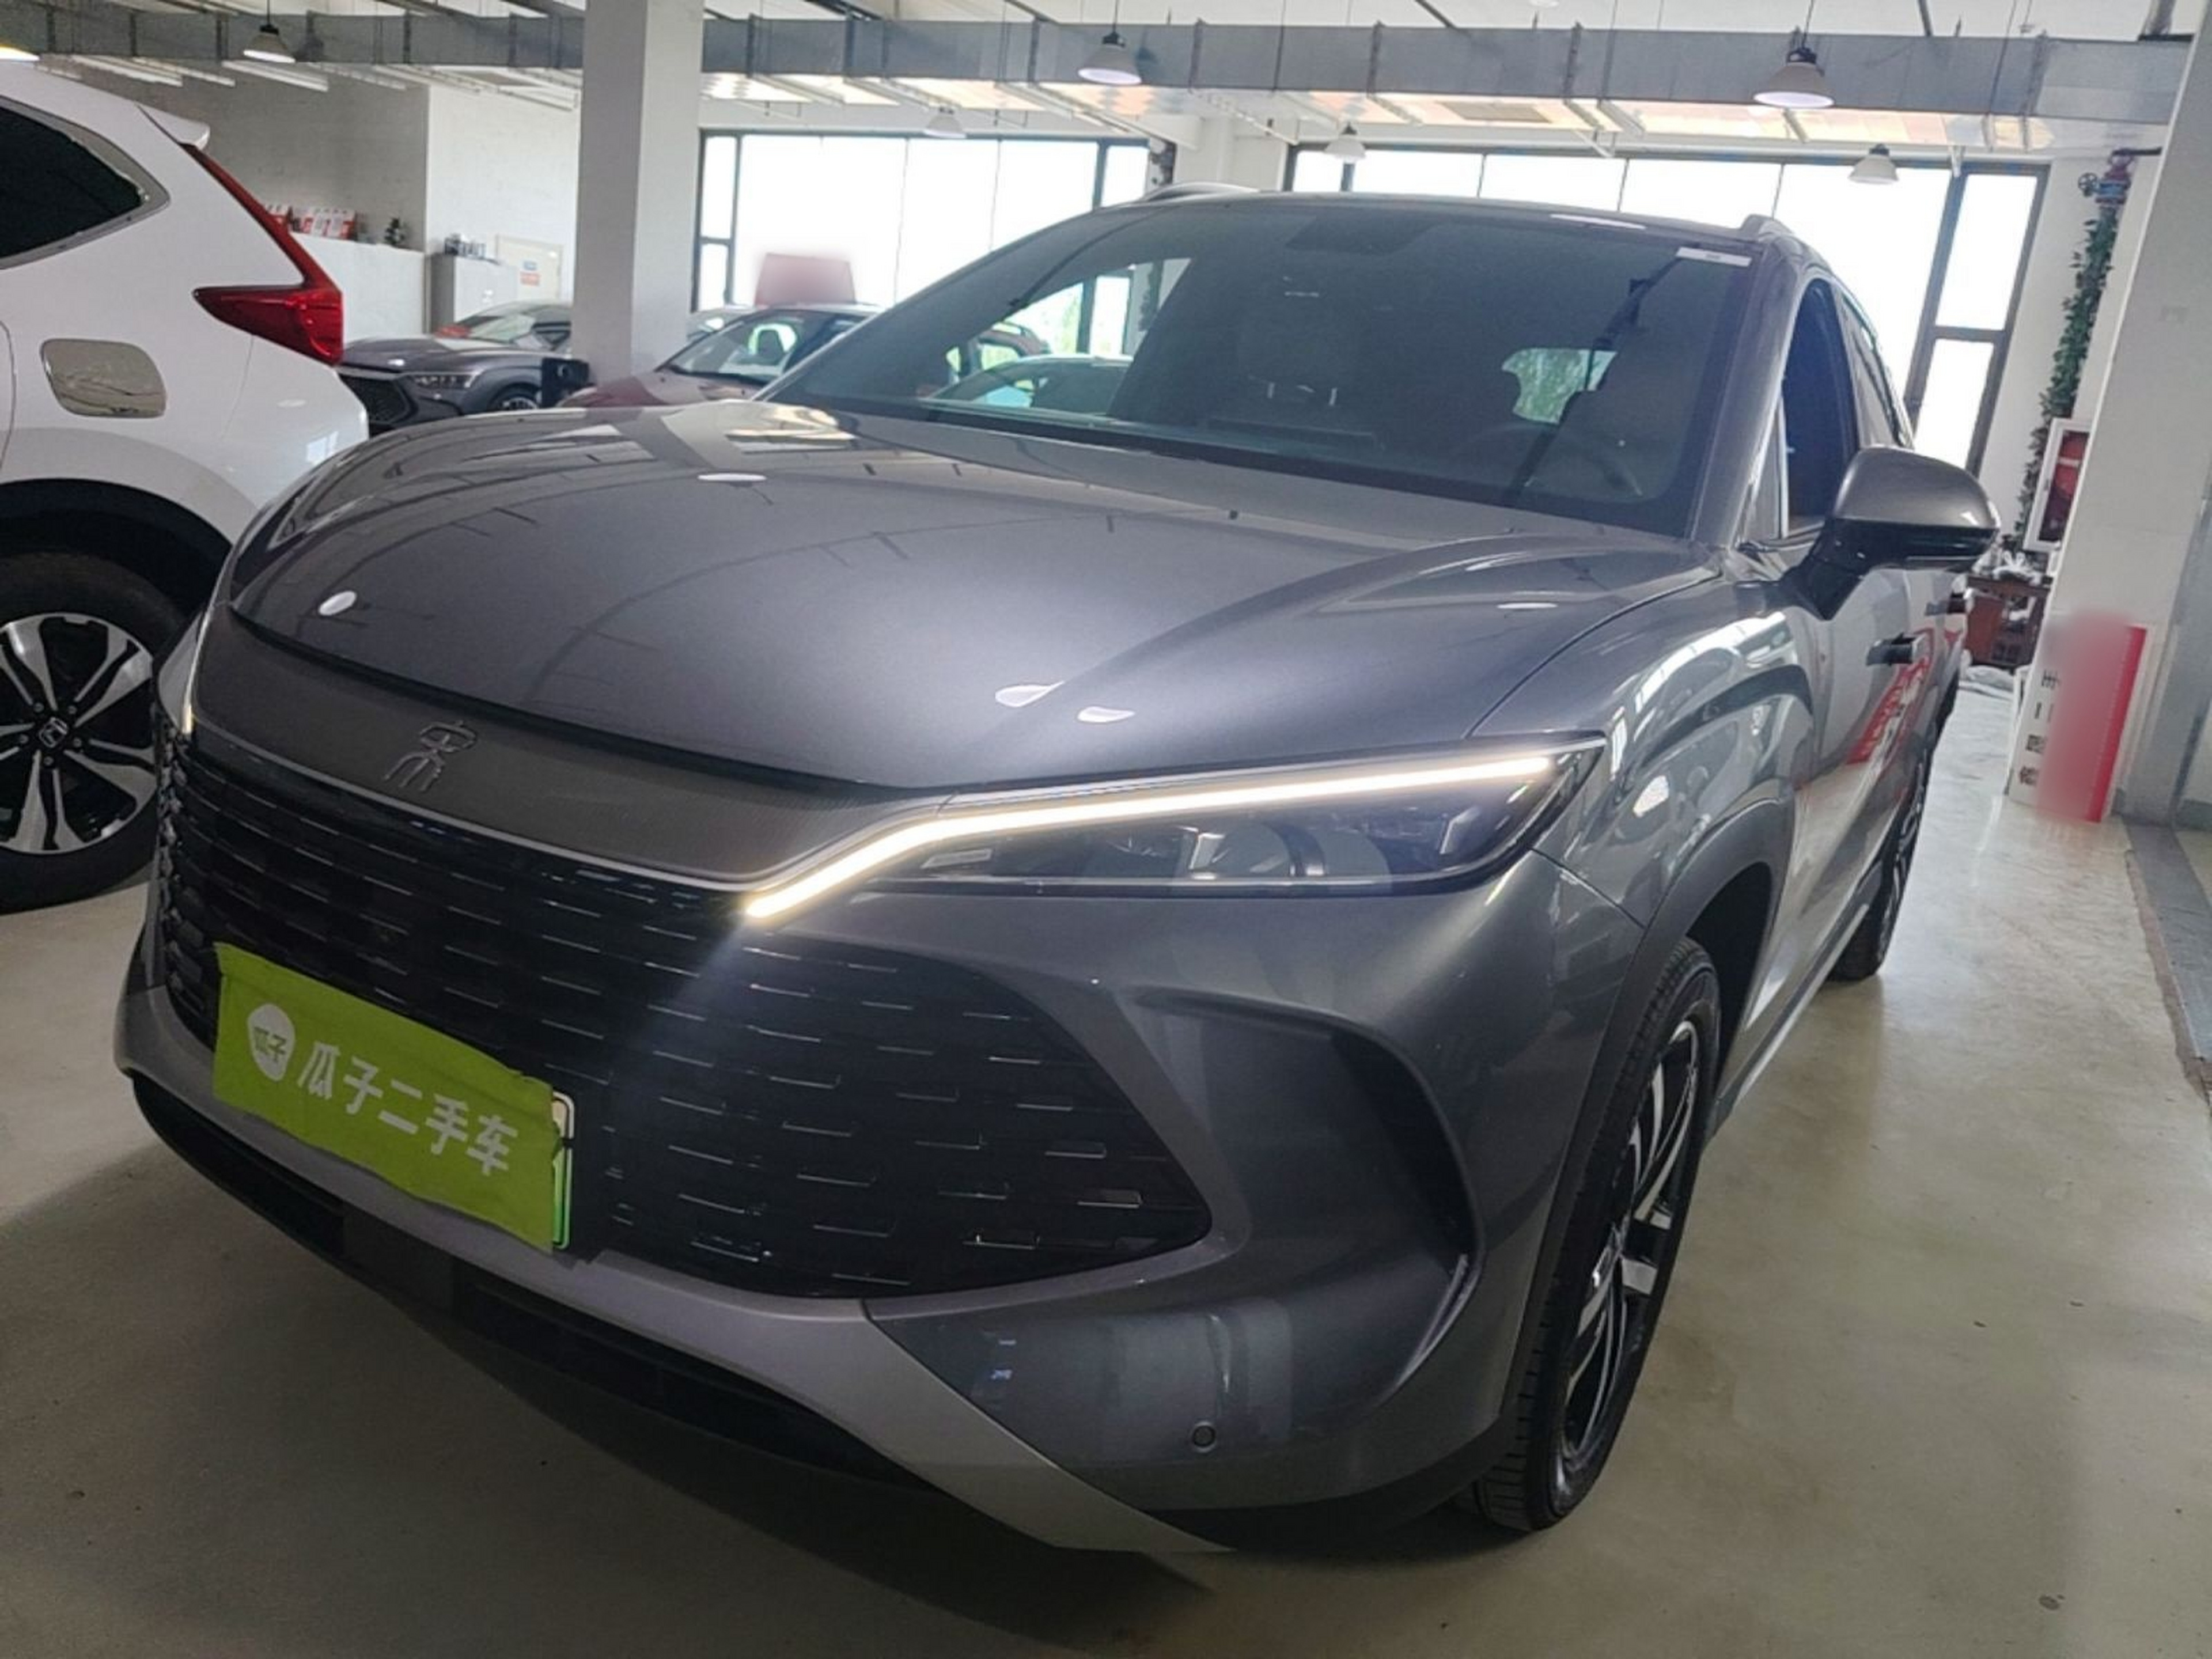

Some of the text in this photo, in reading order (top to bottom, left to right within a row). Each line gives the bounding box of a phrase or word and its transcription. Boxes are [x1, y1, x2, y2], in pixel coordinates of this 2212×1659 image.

[296, 1041, 518, 1176] 瓜子二手车
